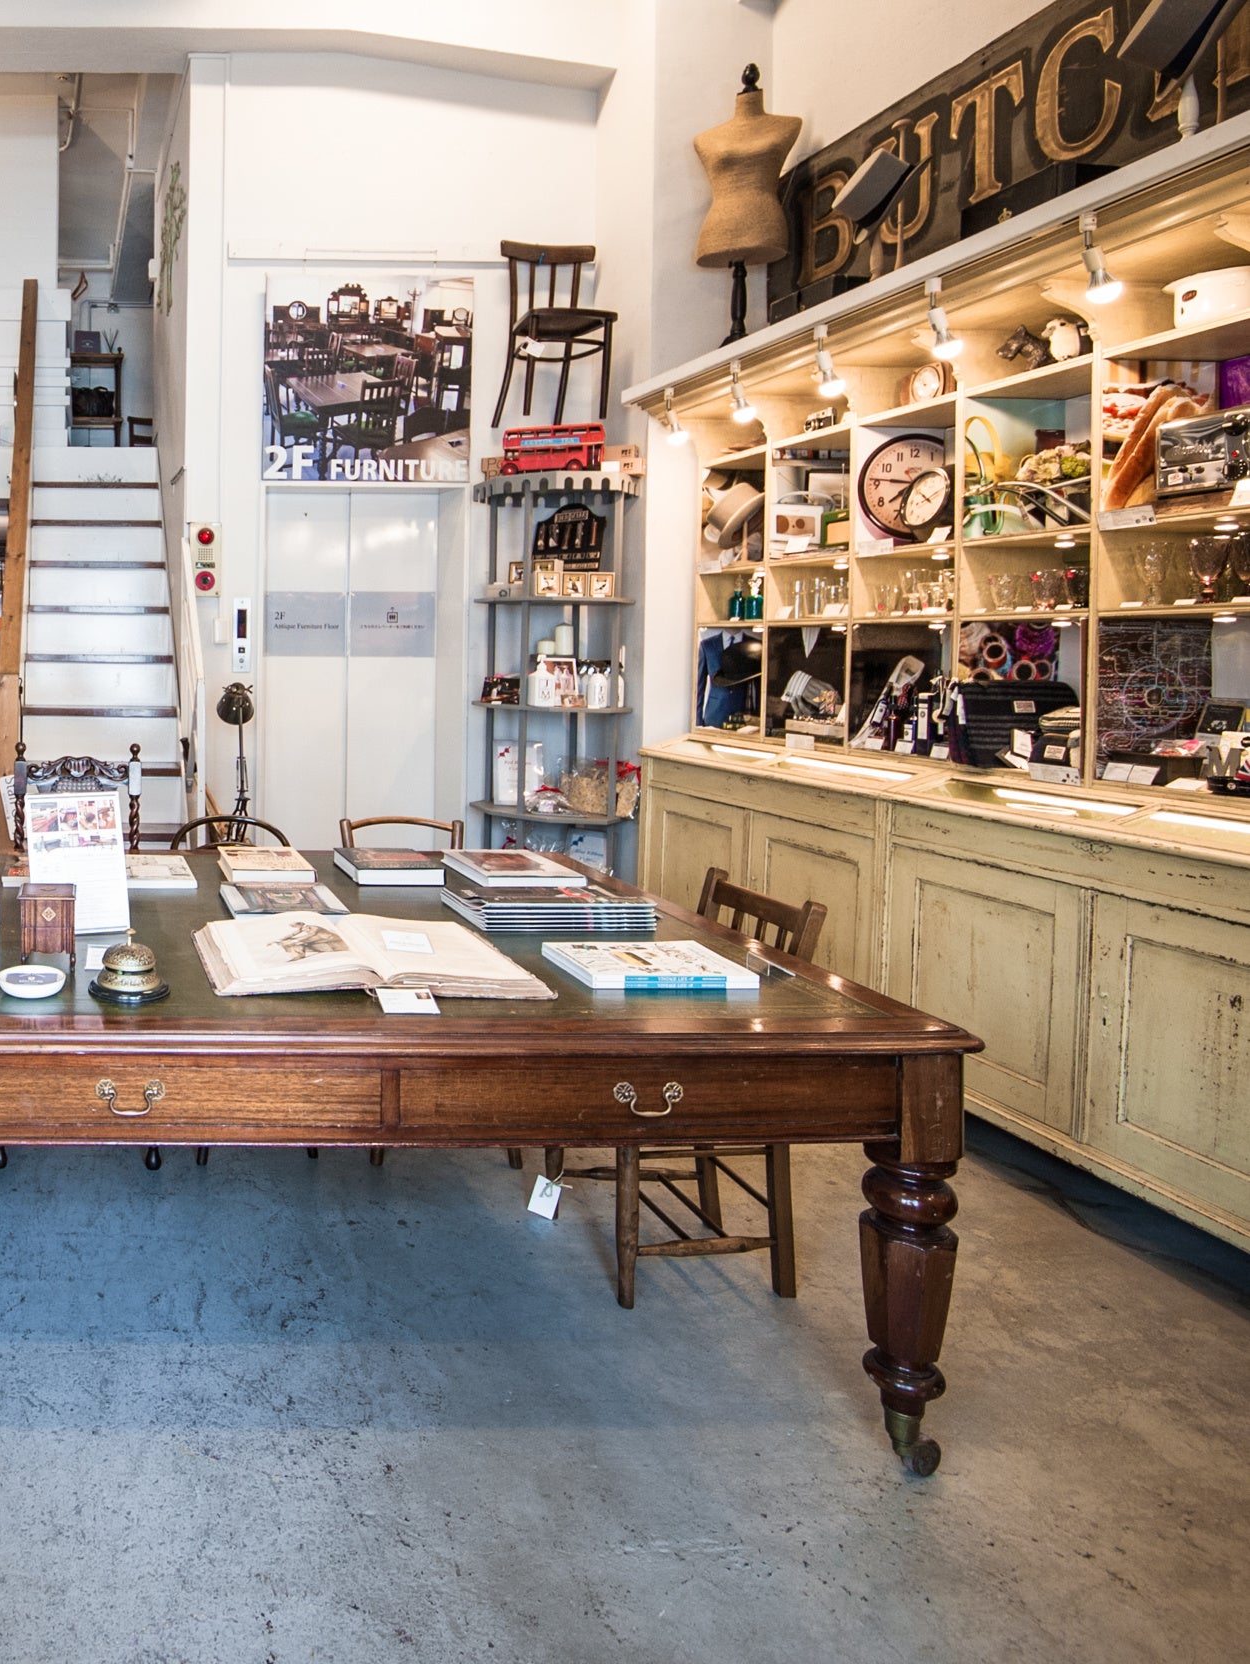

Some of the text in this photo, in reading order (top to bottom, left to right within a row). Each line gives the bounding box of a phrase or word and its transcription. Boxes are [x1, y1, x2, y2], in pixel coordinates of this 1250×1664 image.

[797, 0, 1250, 287] BUTC
[896, 452, 904, 462] 11
[910, 448, 920, 458] 12
[262, 444, 315, 480] 2F
[330, 458, 469, 481] FURNITURE
[881, 463, 892, 473] 10
[873, 480, 881, 490] 9
[877, 496, 885, 508] 8
[893, 509, 901, 521] 7
[274, 611, 286, 620] 2F
[273, 623, 296, 631] Antique
[1206, 746, 1246, 777] M
